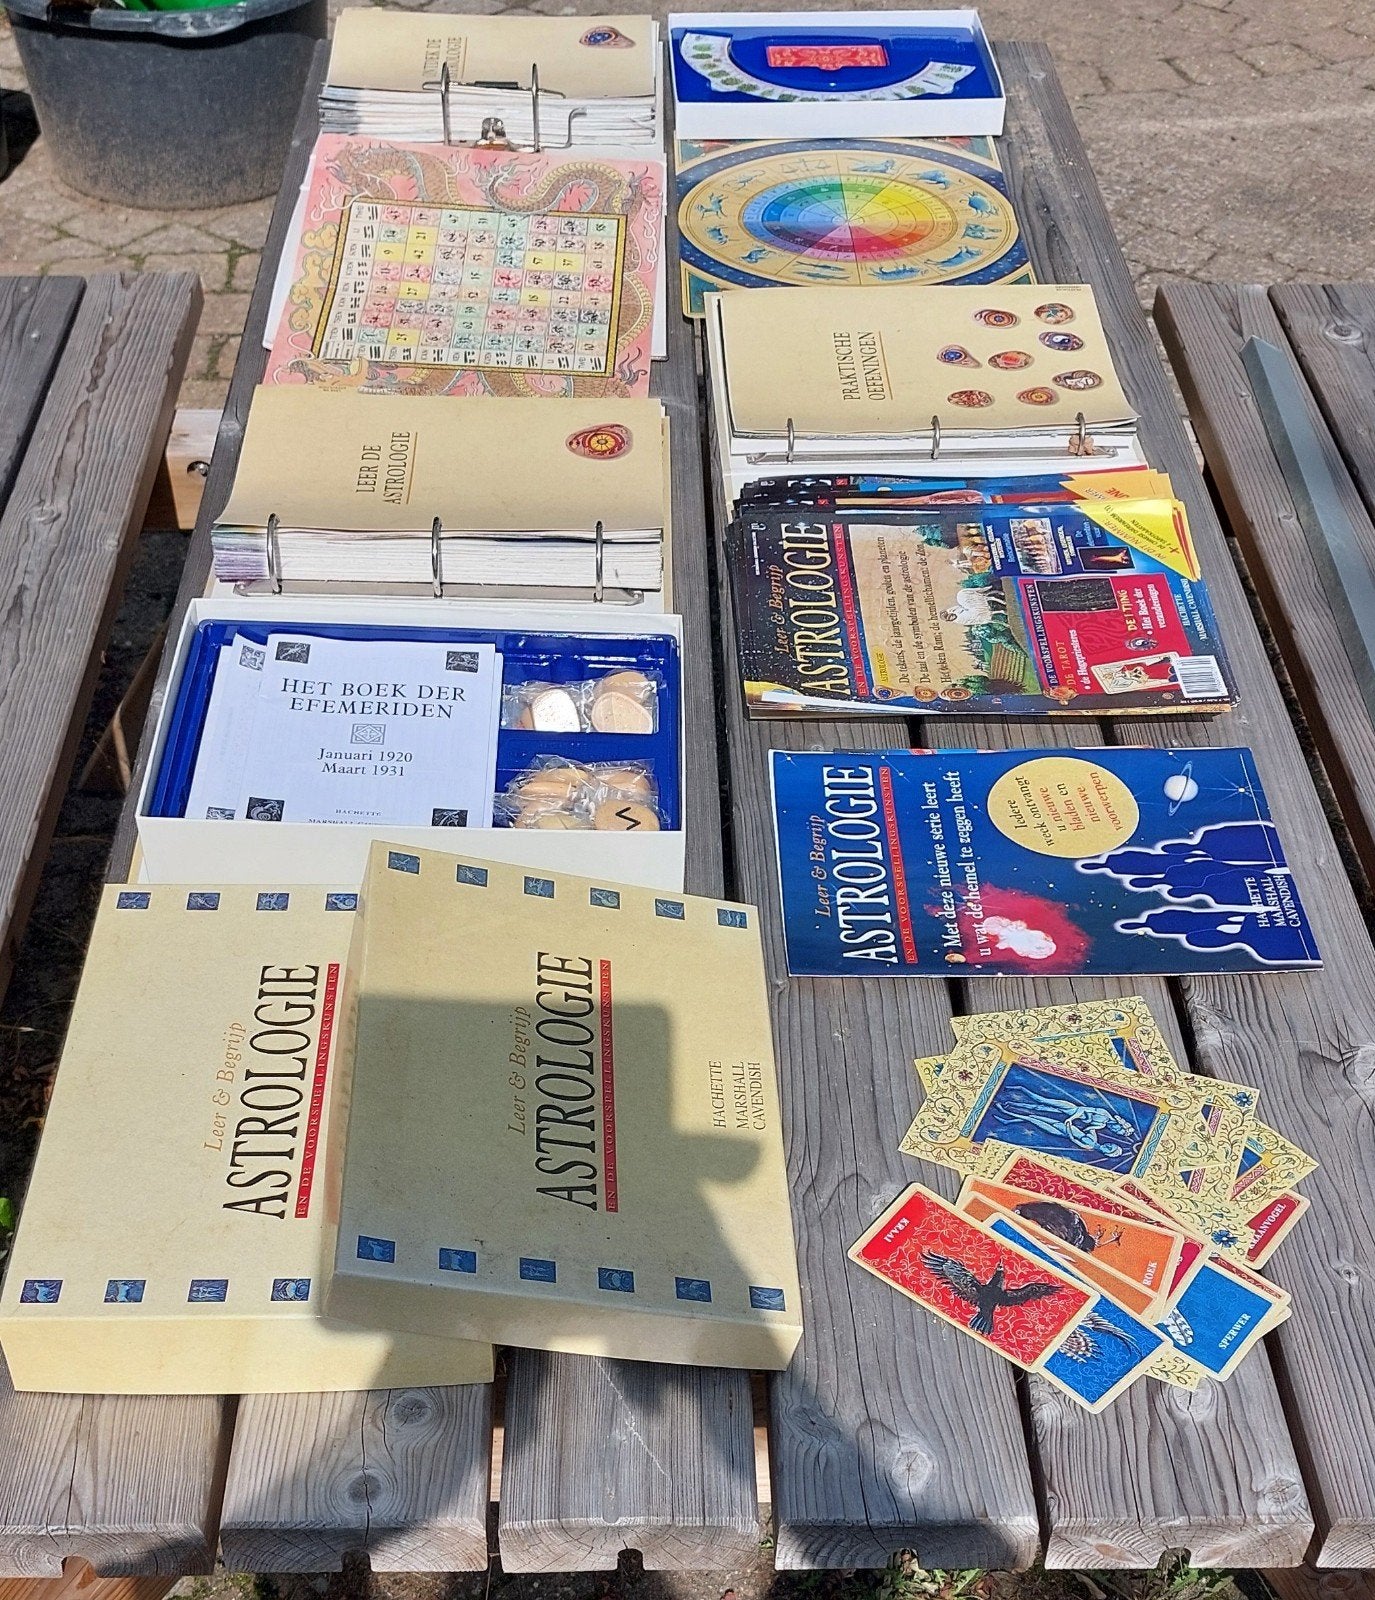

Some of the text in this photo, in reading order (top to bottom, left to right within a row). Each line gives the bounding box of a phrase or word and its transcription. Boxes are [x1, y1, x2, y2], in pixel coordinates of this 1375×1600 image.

[834, 332, 860, 400] PRAKTISCHE
[858, 332, 885, 400] OEFENINGEN
[356, 445, 381, 493] LEER DE
[382, 432, 410, 504] ASTROLOGIE
[877, 537, 891, 564] planeten
[883, 565, 890, 573] en
[918, 558, 928, 566] de
[885, 575, 896, 595] goden
[1118, 590, 1133, 612] TJING
[1133, 588, 1142, 598] der
[1136, 599, 1150, 615] Boek
[1147, 584, 1166, 628] veranderingen
[766, 564, 790, 653] Leer & Begrijp
[781, 523, 850, 695] ASTROLOGIE
[835, 526, 867, 695] EN DE VOORSPELLINGSKUNSTEN
[898, 551, 931, 683] De taal en de symbolen van de astrologie
[929, 622, 940, 630] de
[1025, 584, 1054, 673] VOORSPELLINGSKUNSTEN
[1126, 619, 1137, 631] DE
[1174, 594, 1190, 626] HACHETTE
[1181, 579, 1207, 640] MARSHALL CAVENDISH
[893, 640, 902, 648] de
[895, 650, 908, 672] tekens,
[936, 653, 949, 670] teken
[1056, 640, 1077, 685] DE TAROT
[281, 678, 466, 702] HET BOEK DER
[899, 674, 910, 683] De
[941, 670, 951, 683] Het
[1049, 675, 1058, 683] DE
[289, 698, 453, 718] EFEMERIDEN
[317, 748, 412, 762] Januari 1920
[321, 763, 405, 776] Maart 1931
[1007, 800, 1028, 829] Iedere
[1015, 776, 1054, 846] week ontvangt
[1039, 787, 1063, 822] nieuwe
[1056, 783, 1085, 832] bladen en
[1076, 786, 1100, 822] nieuwe
[1089, 772, 1124, 831] voorwerpen
[806, 815, 831, 917] Leer & Begrijp
[823, 766, 899, 963] ASTROLOGIE
[881, 768, 915, 961] EN DE VOORSPELLINGSKUNSTEN
[921, 782, 962, 947] Met deze nieuwe serie leert
[942, 771, 991, 956] u wat de hemel te zeggen heeft
[1273, 875, 1301, 927] CAVENDISH
[204, 1022, 246, 1151] Leer & Begrijp
[222, 964, 319, 1219] ASTROLOGIE
[298, 965, 337, 1215] EN DE VOORSPELLINGSKUNSTEN
[507, 1006, 530, 1136] Leer & Begrijp
[535, 952, 597, 1211] ASTROLOGIE
[601, 962, 616, 1209] EN DE VOORSPELLINGSKUNSTEN
[709, 1060, 726, 1128] HACHETTE
[732, 1061, 749, 1129] MARSHALL
[748, 1062, 766, 1130] CAVENDISH
[883, 1217, 909, 1243] KRAAI
[1142, 1260, 1157, 1286] ROEK
[1218, 1313, 1251, 1350] SPERWER
